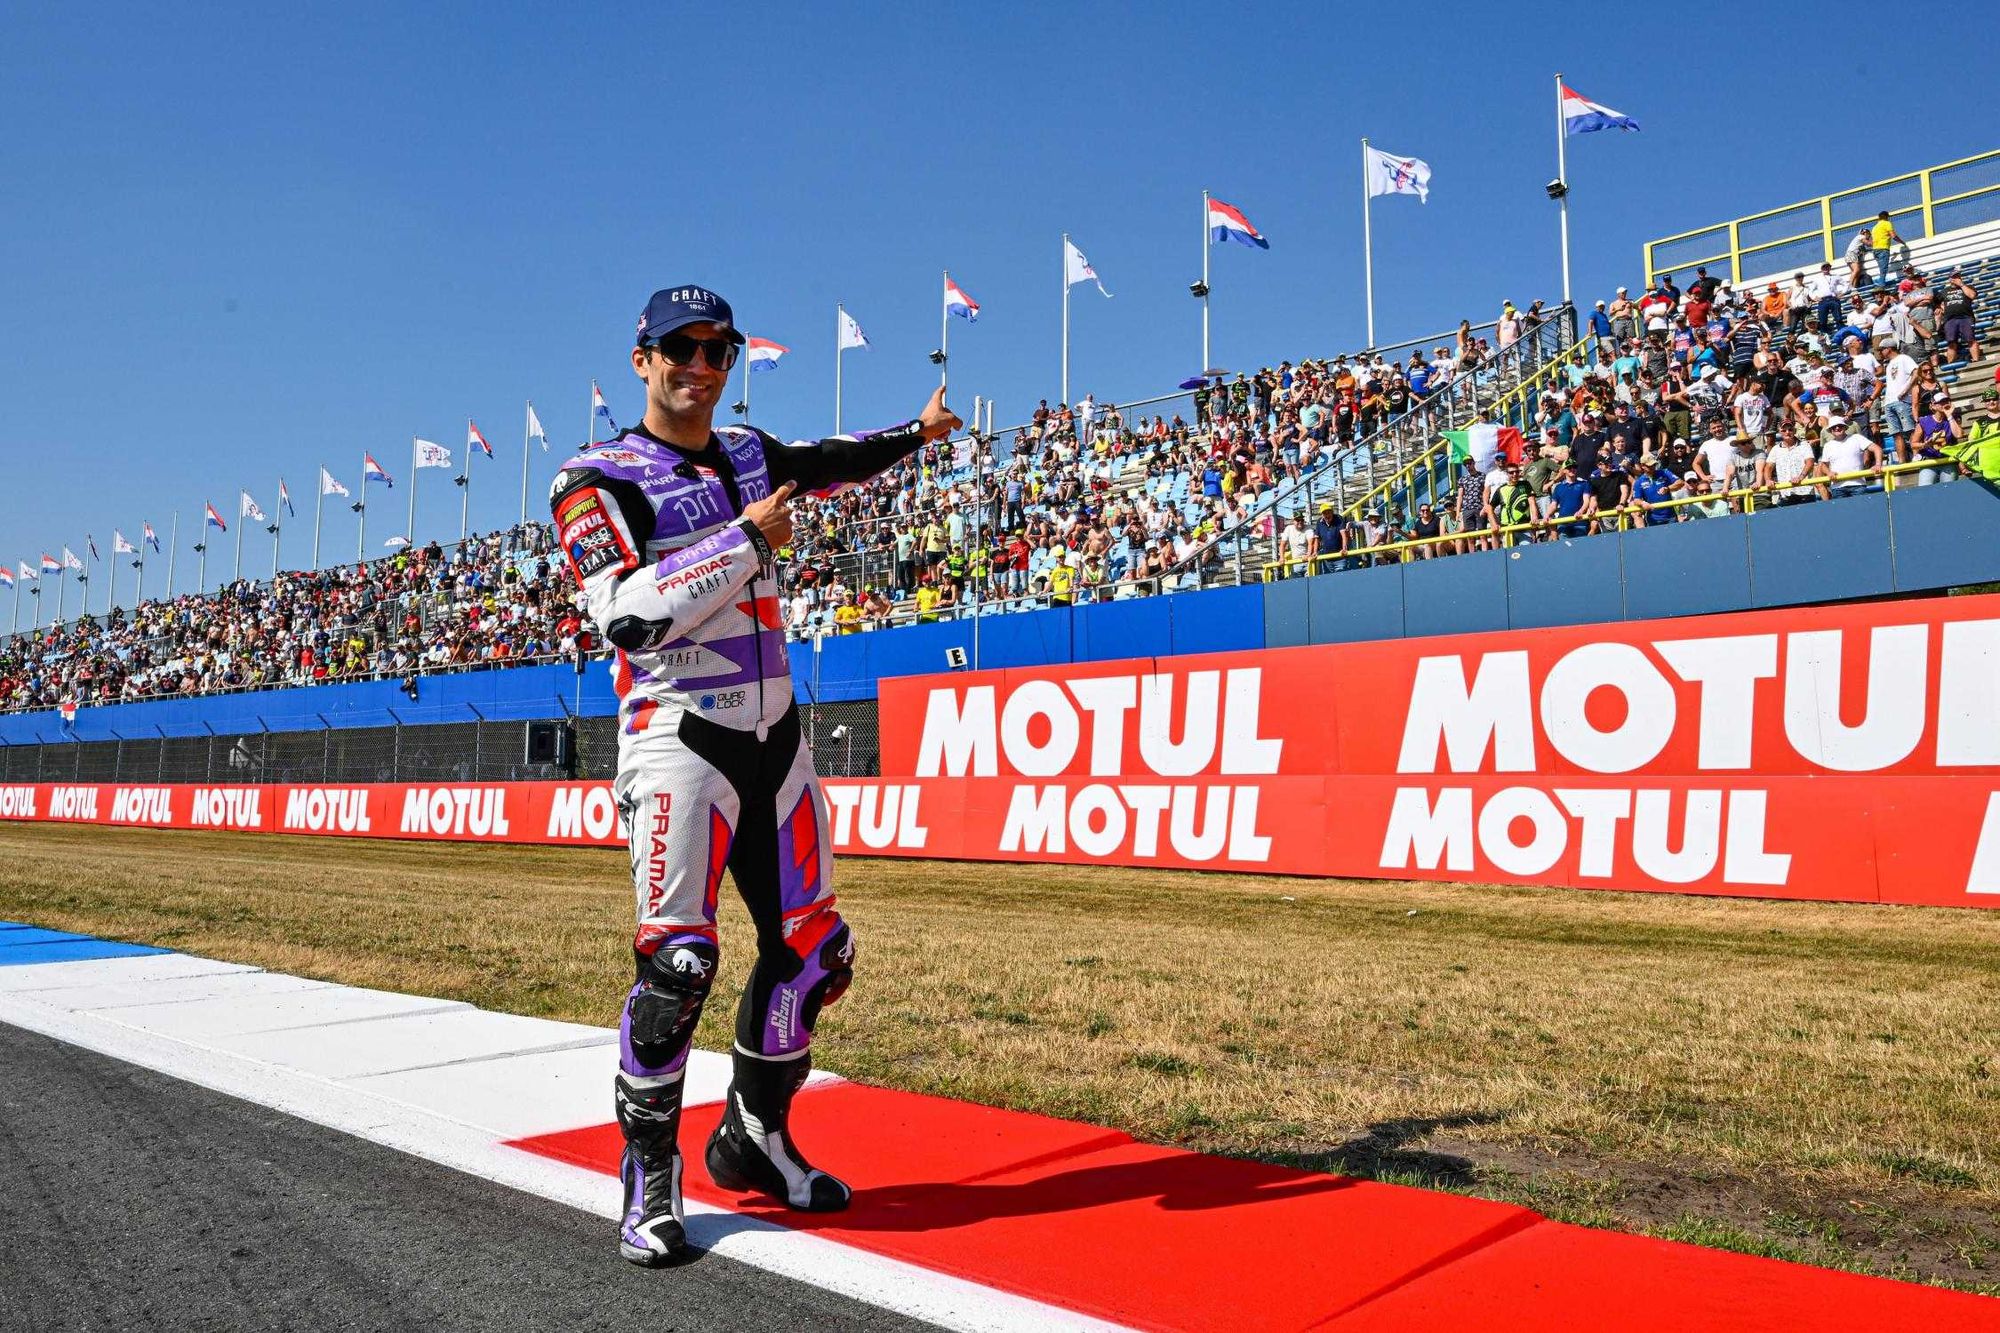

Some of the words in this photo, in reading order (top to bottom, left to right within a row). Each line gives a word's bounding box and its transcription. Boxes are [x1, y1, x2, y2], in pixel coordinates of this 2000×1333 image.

[671, 288, 717, 306] CRAFT
[638, 473, 681, 490] SHARK
[578, 545, 619, 577] CRAFT
[673, 540, 719, 566] prima
[656, 554, 733, 596] PRAMAC
[687, 569, 731, 600] CRAFT
[951, 648, 963, 665] E
[716, 699, 744, 710] LOCK
[717, 690, 746, 701] QUAD
[916, 667, 1284, 776] MOTUL
[49, 787, 98, 819] MOTUL
[111, 788, 172, 823] MOTUL
[191, 788, 262, 827] MOTUL
[284, 789, 371, 832] MOTUL
[400, 788, 509, 836] MOTUL
[999, 784, 1272, 861] MOTUL
[1379, 786, 1792, 885] MOTUL
